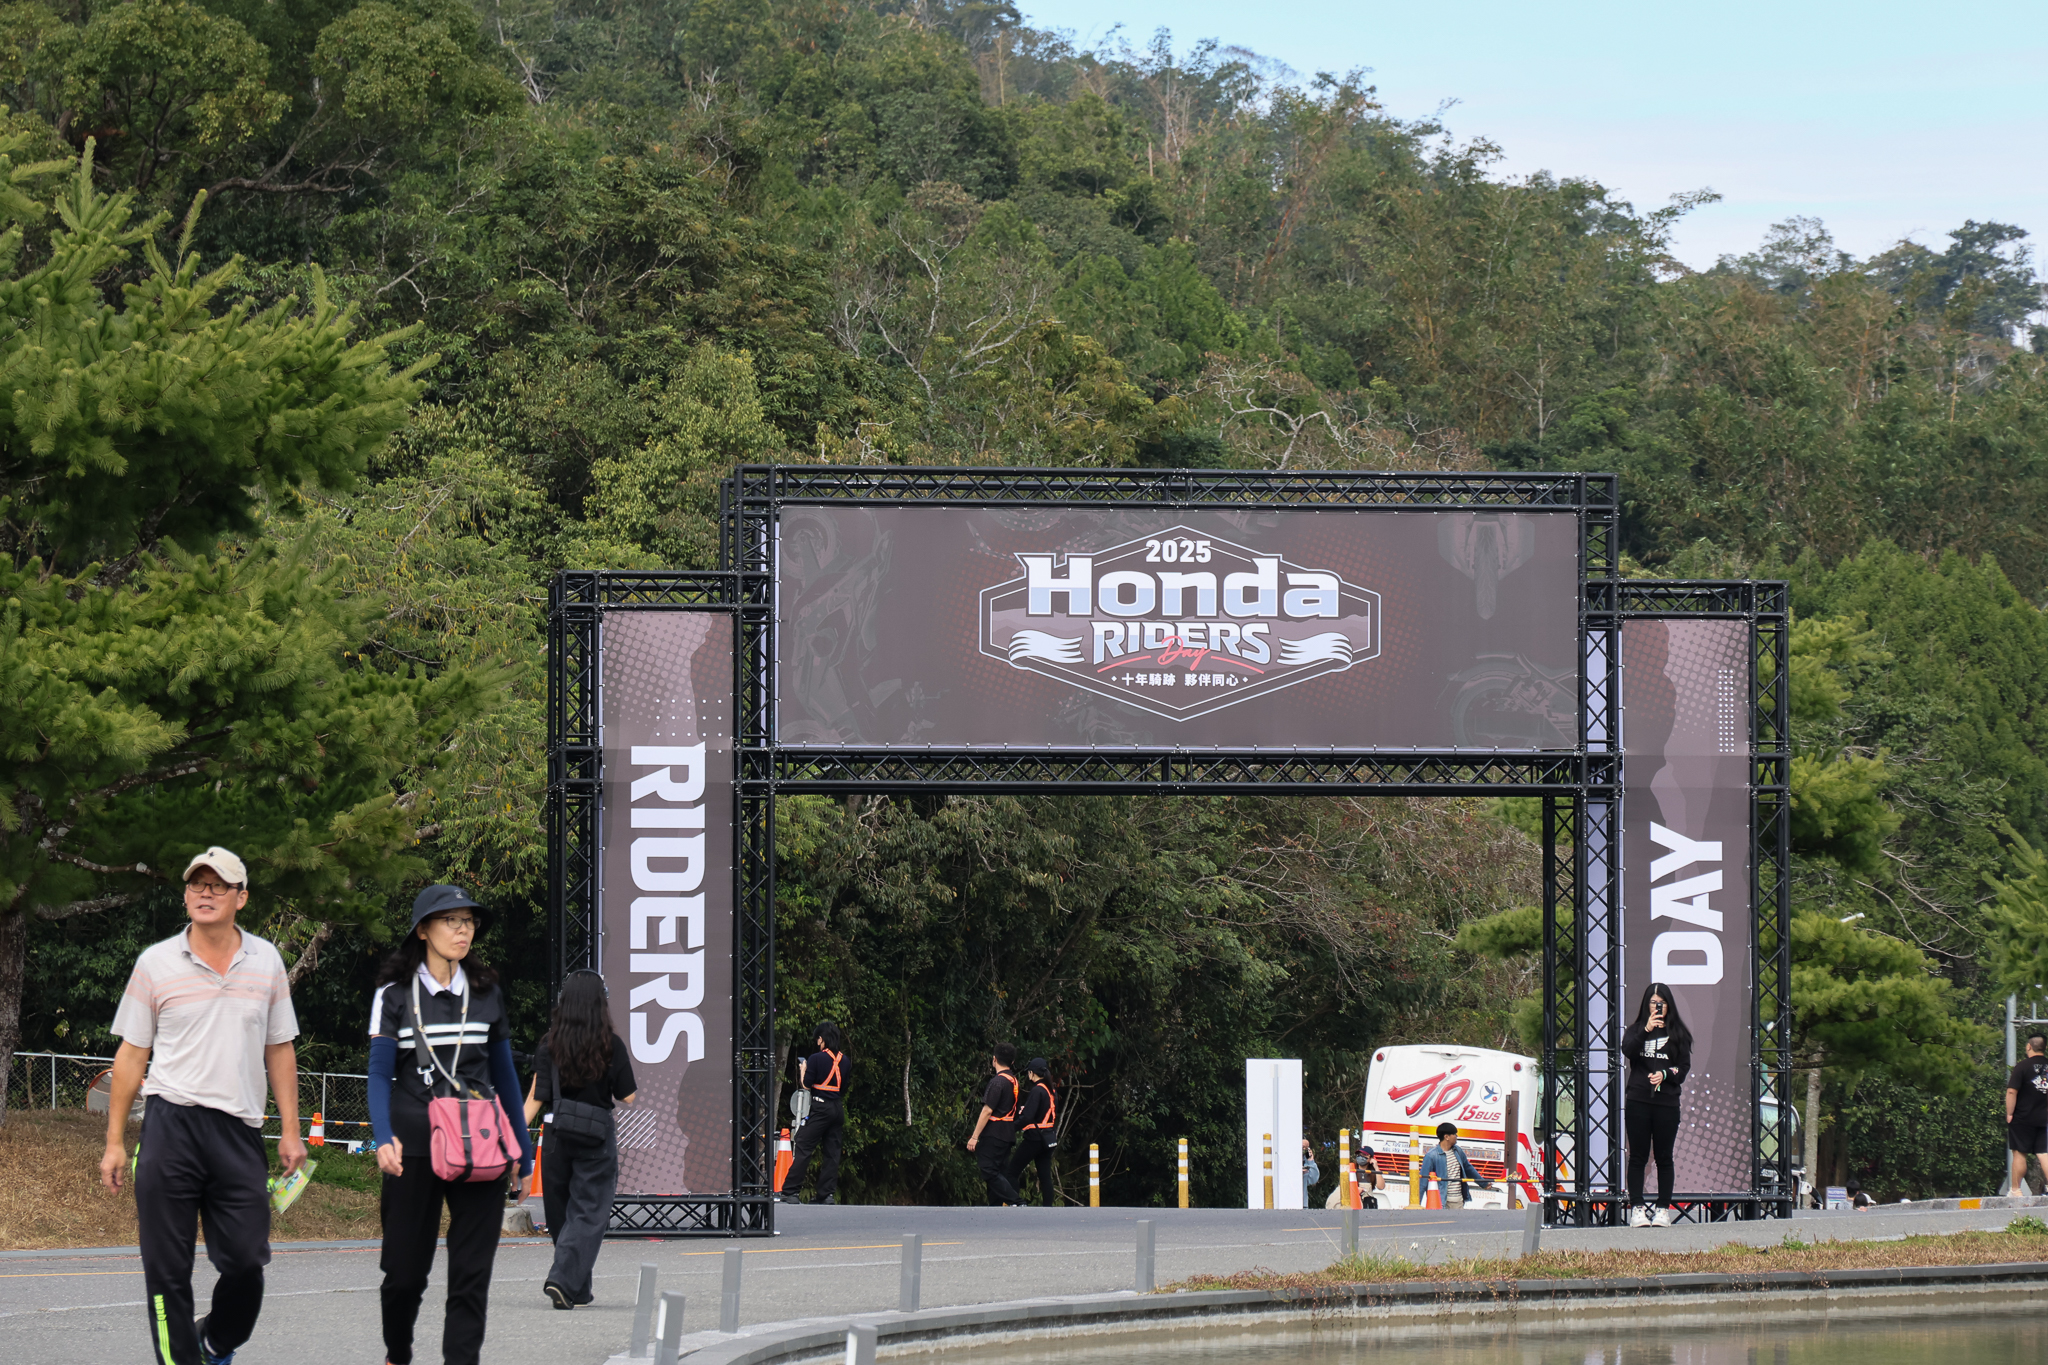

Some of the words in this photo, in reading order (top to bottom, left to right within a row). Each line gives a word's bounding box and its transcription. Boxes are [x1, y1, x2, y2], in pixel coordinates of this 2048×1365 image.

[1145, 539, 1212, 563] 2025
[1022, 556, 1340, 618] Honda
[1090, 621, 1271, 665] RIDERS
[1157, 635, 1211, 671] Day
[1121, 672, 1176, 687] 十年騎跡
[1184, 673, 1240, 687] 夥伴同心
[629, 741, 706, 1064] RIDERS
[1650, 820, 1723, 986] DAY
